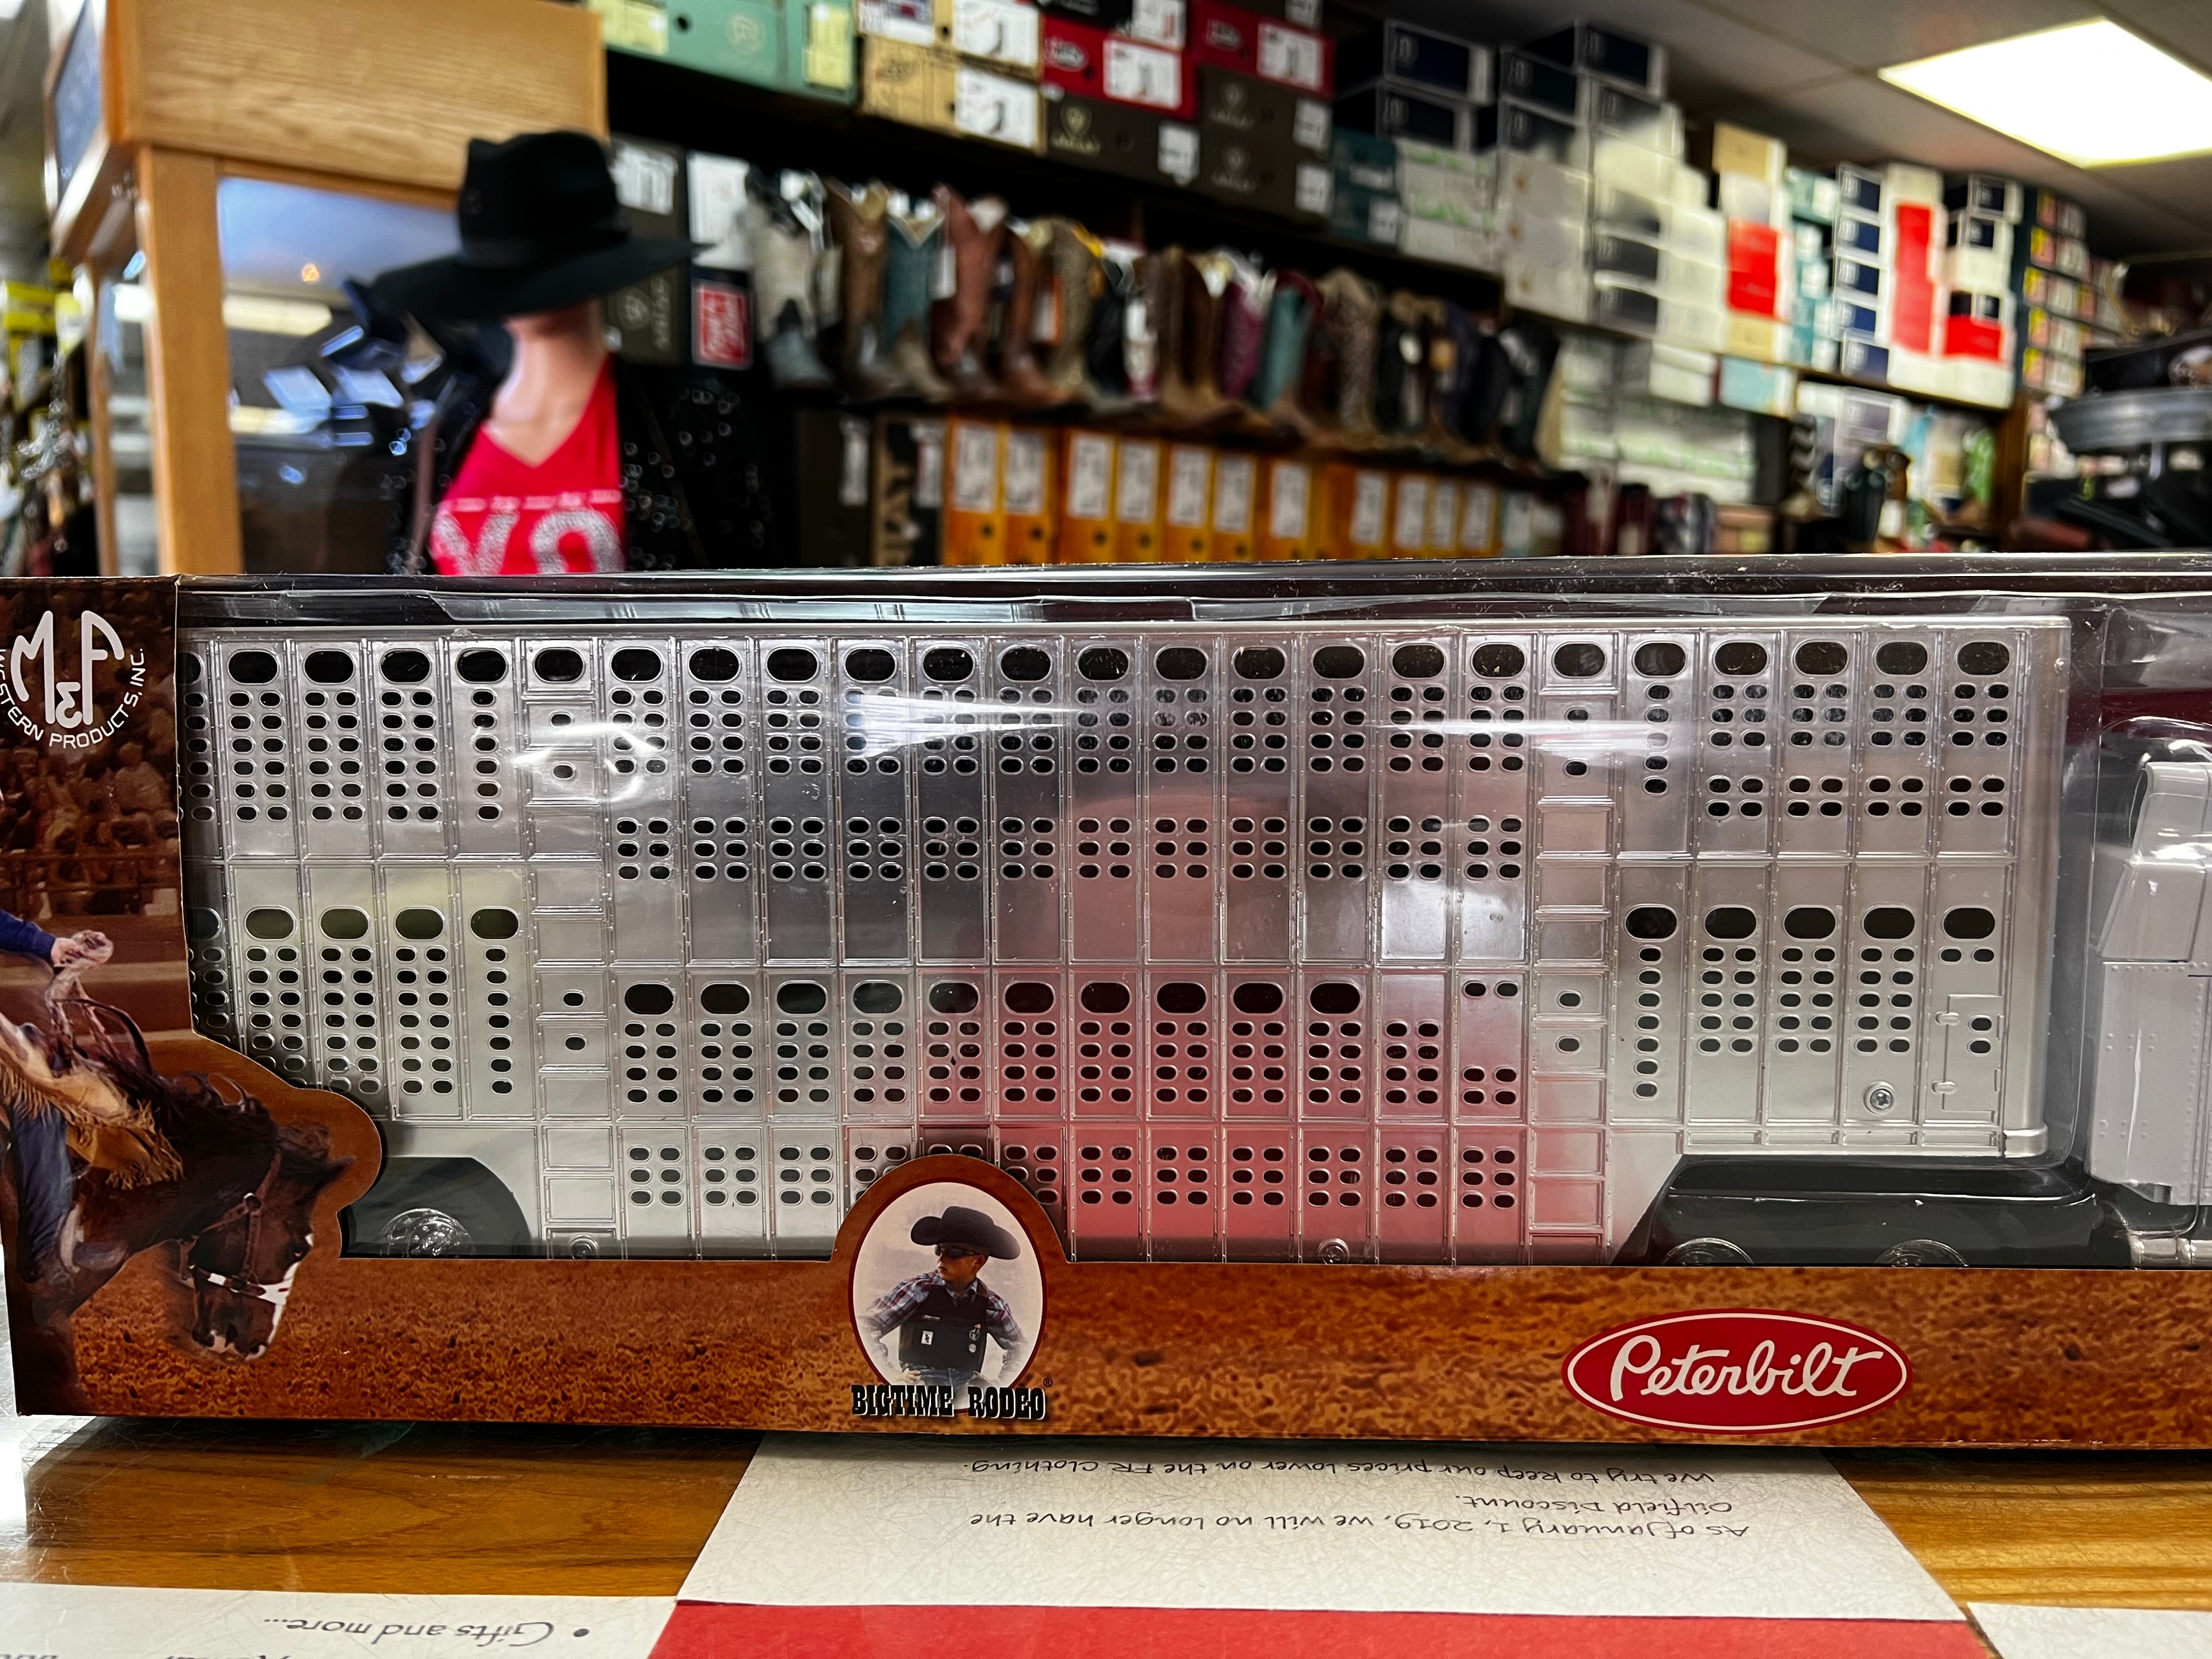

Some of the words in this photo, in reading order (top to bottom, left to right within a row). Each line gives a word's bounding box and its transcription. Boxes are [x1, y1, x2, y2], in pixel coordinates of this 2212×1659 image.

[130, 647, 146, 687] INC.
[1609, 1334, 1884, 1402] Peterbilt
[850, 1384, 955, 1418] BIGTIME
[967, 1385, 1047, 1421] RODEO
[1108, 1463, 1153, 1475] FR
[1164, 1463, 1207, 1475] the
[1215, 1460, 1252, 1470] on
[1347, 1459, 1433, 1475] prices
[1438, 1465, 1487, 1476] our
[1497, 1465, 1562, 1484] keep
[1570, 1472, 1600, 1484] to
[1605, 1467, 1658, 1484] try
[1664, 1472, 1715, 1483] We
[1455, 1495, 1605, 1514] Discount.
[1612, 1498, 1733, 1517] Oilfield
[969, 1513, 1016, 1527] the
[1026, 1512, 1094, 1527] have
[1104, 1512, 1204, 1530] longer
[1216, 1515, 1253, 1527] no
[1264, 1516, 1324, 1530] will
[1334, 1514, 1374, 1526] we
[1484, 1520, 1514, 1533] 1,
[1522, 1517, 1667, 1536] January
[1663, 1521, 1695, 1539] of
[1705, 1525, 1750, 1537] As
[263, 1618, 372, 1634] more...
[370, 1622, 446, 1645] and
[453, 1622, 555, 1647] Gifts
